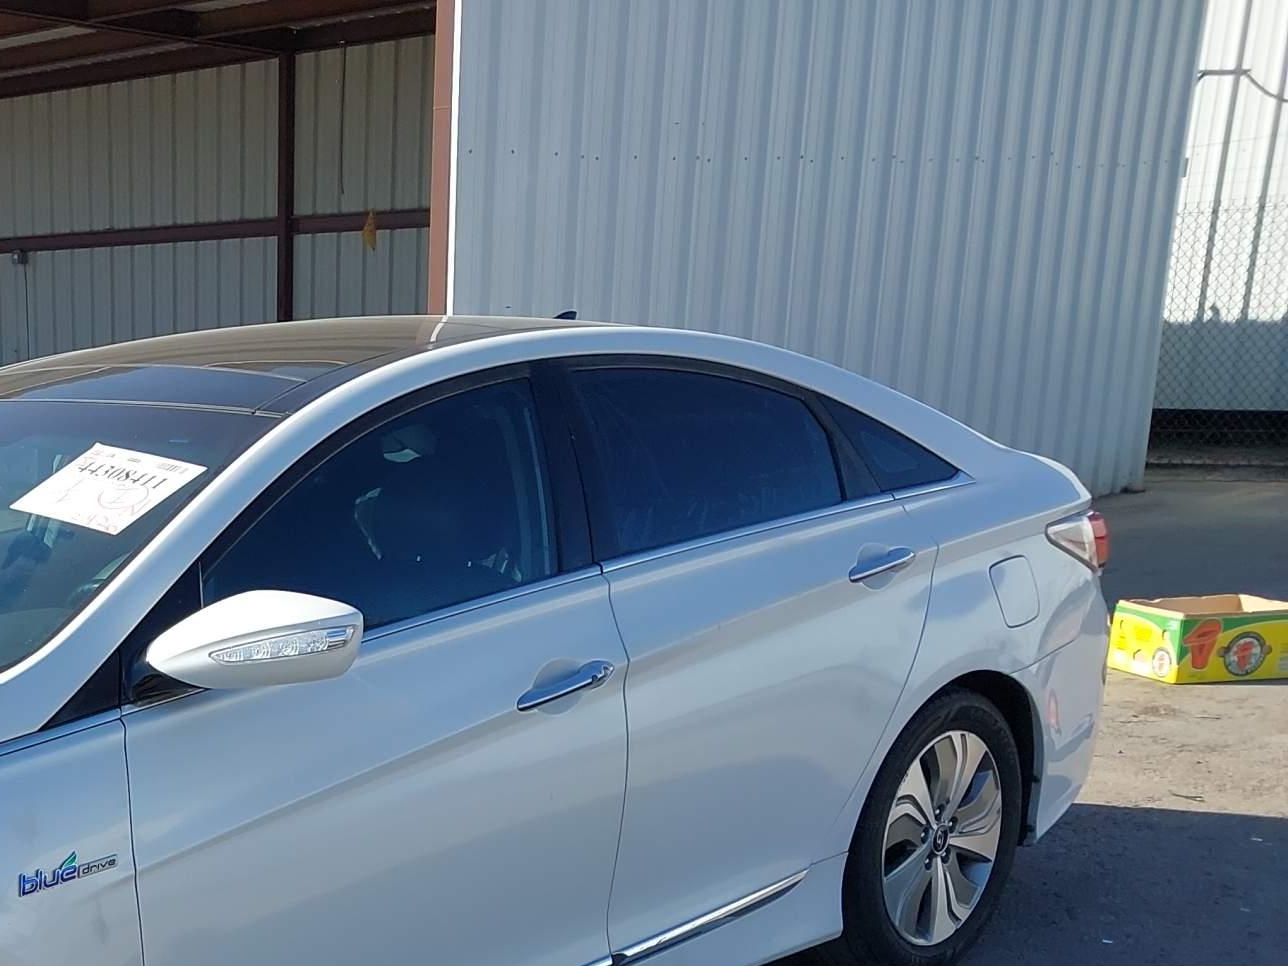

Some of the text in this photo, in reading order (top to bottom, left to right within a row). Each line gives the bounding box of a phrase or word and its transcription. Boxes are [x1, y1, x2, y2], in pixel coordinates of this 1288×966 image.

[78, 461, 168, 489] 44308411
[18, 859, 116, 897] blue drive
